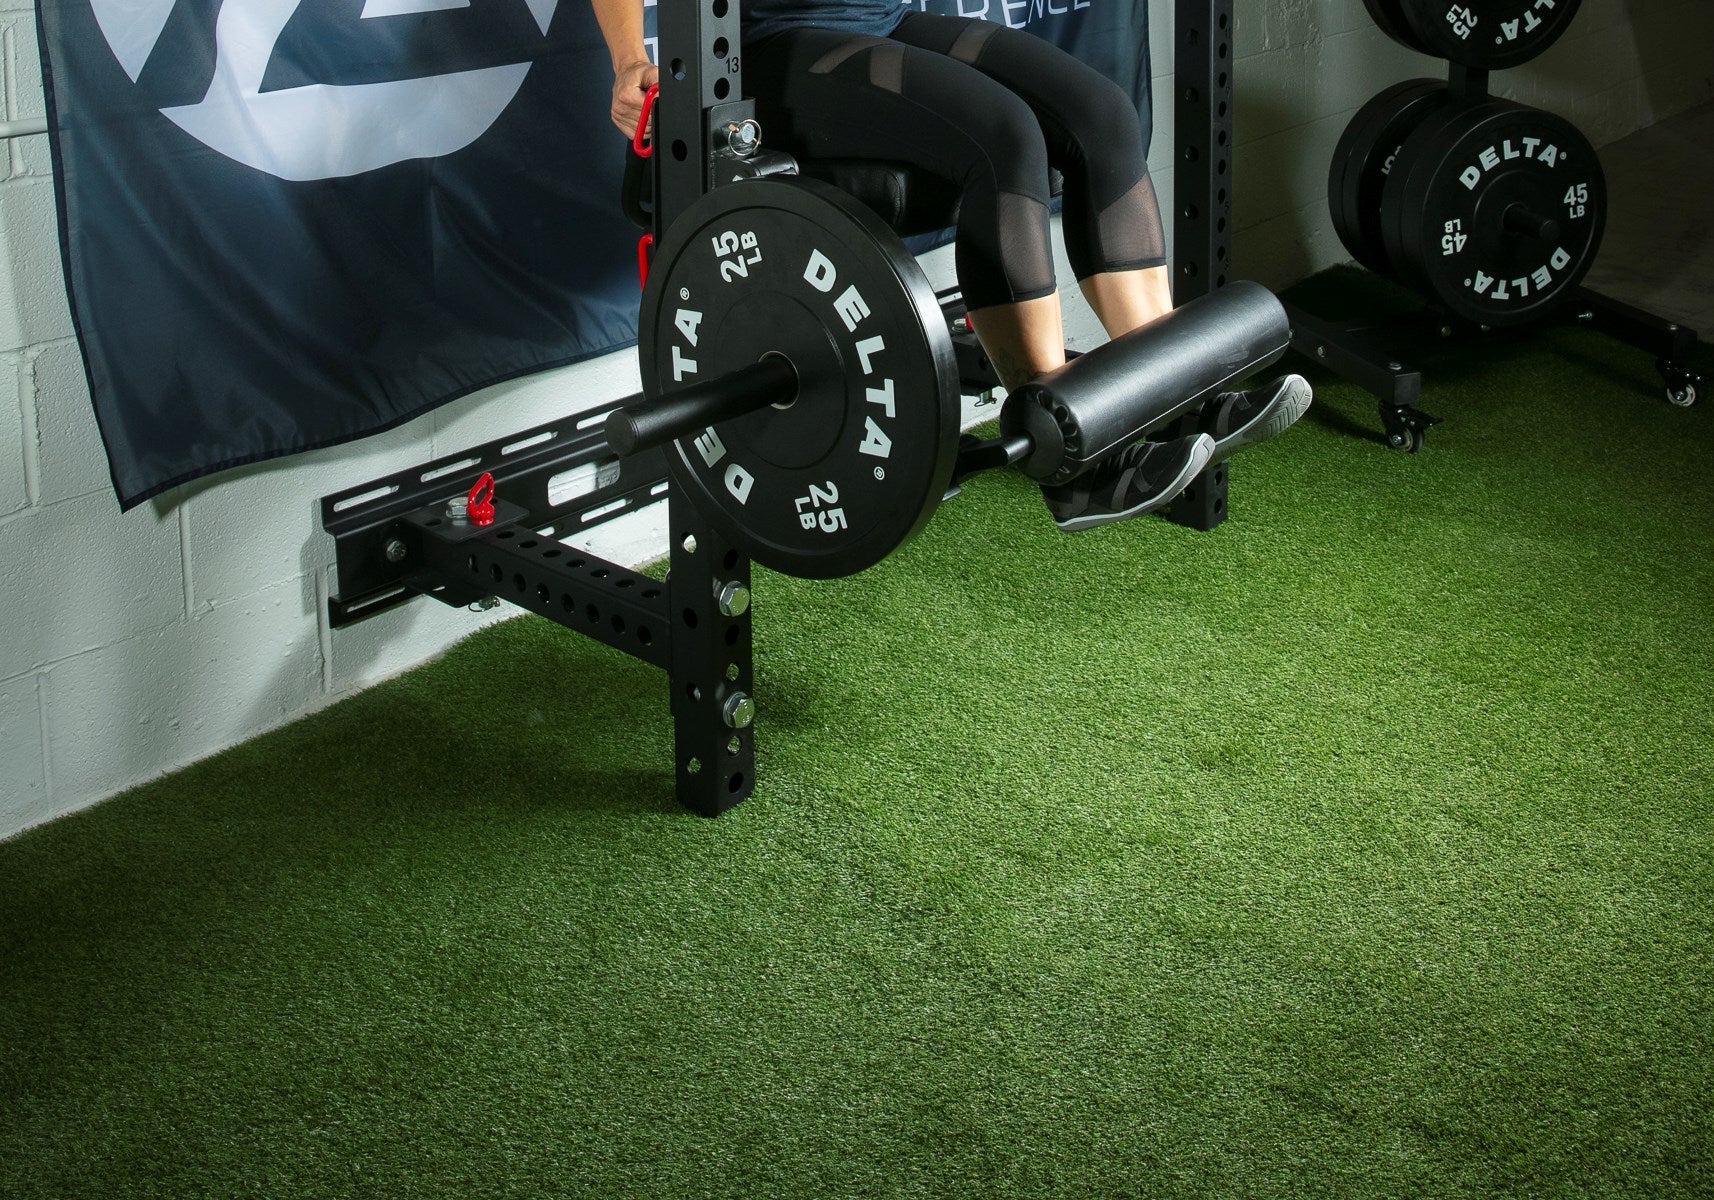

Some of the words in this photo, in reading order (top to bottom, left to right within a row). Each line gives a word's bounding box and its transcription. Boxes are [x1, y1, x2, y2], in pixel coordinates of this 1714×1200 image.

[1446, 4, 1463, 24] LB
[1453, 7, 1478, 40] 25
[725, 57, 739, 74] 13
[1563, 183, 1588, 206] 45
[1569, 205, 1586, 219] LB
[1444, 219, 1462, 234] LB
[741, 230, 763, 266] LB
[1441, 232, 1468, 256] 45
[712, 230, 749, 283] 25
[795, 497, 817, 530] LB
[809, 481, 848, 533] 25
